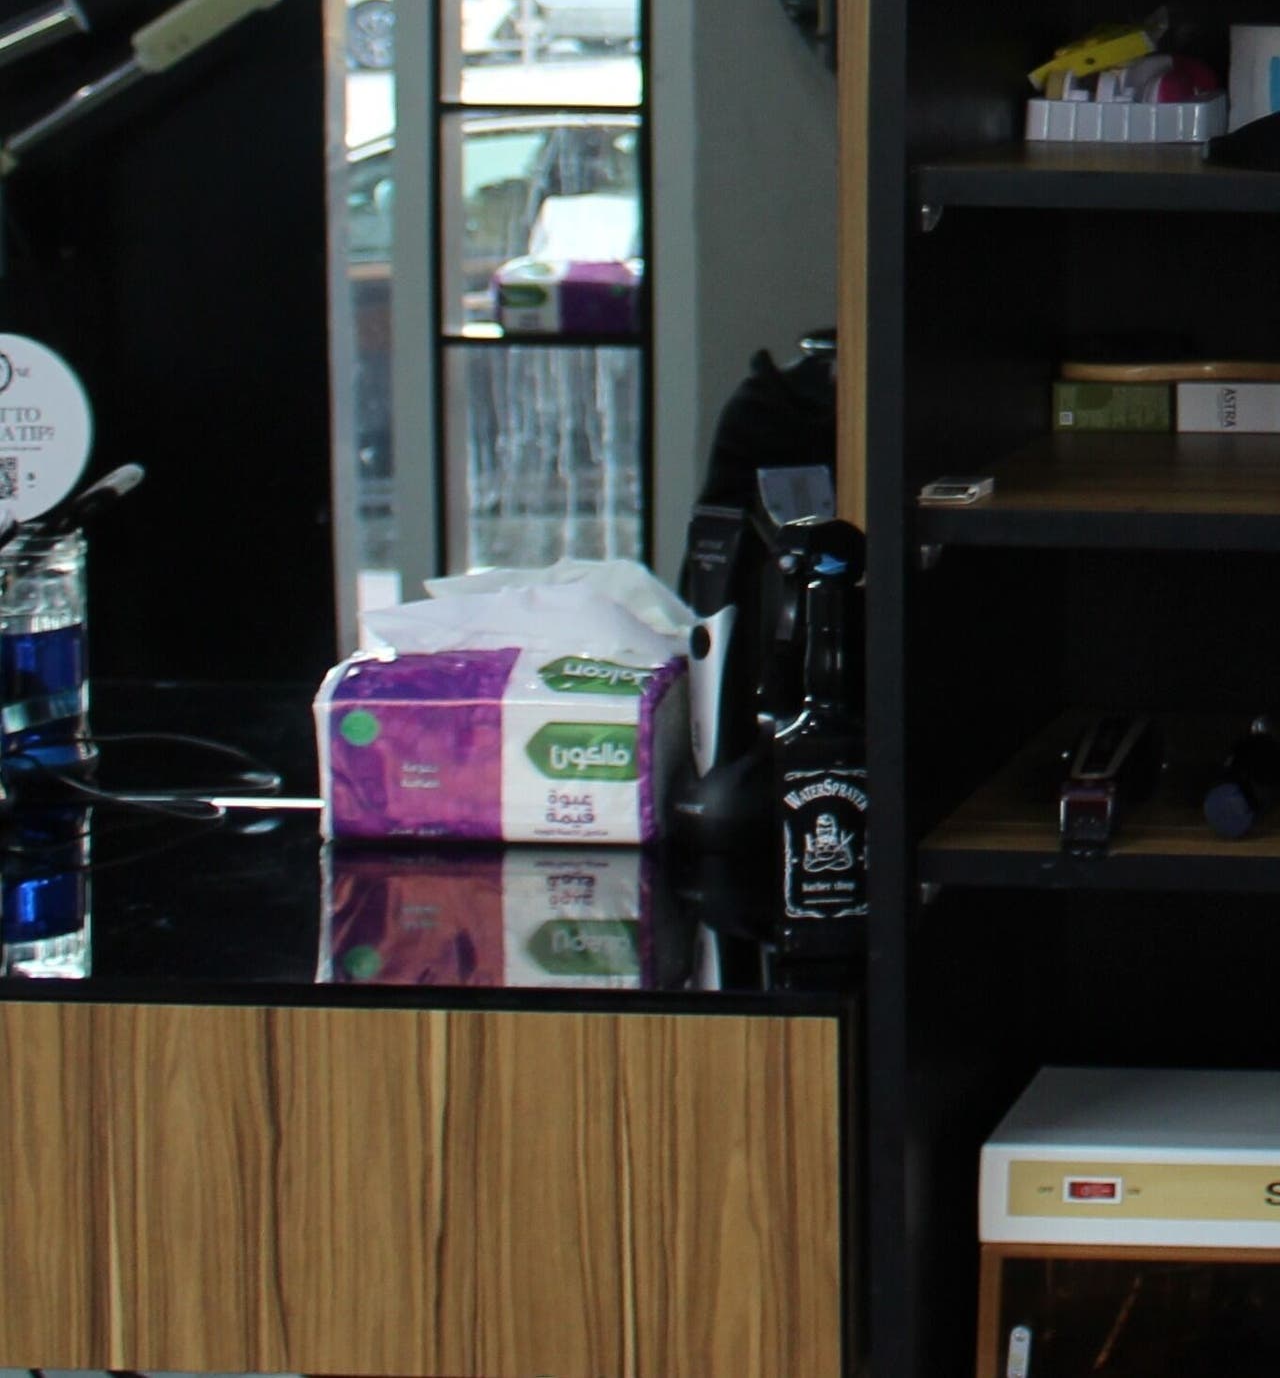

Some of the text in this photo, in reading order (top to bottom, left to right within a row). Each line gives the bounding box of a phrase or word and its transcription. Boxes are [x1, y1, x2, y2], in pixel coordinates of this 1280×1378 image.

[1223, 388, 1237, 428] ASTRA
[551, 742, 631, 771] فالكون
[548, 790, 593, 807] عبوة
